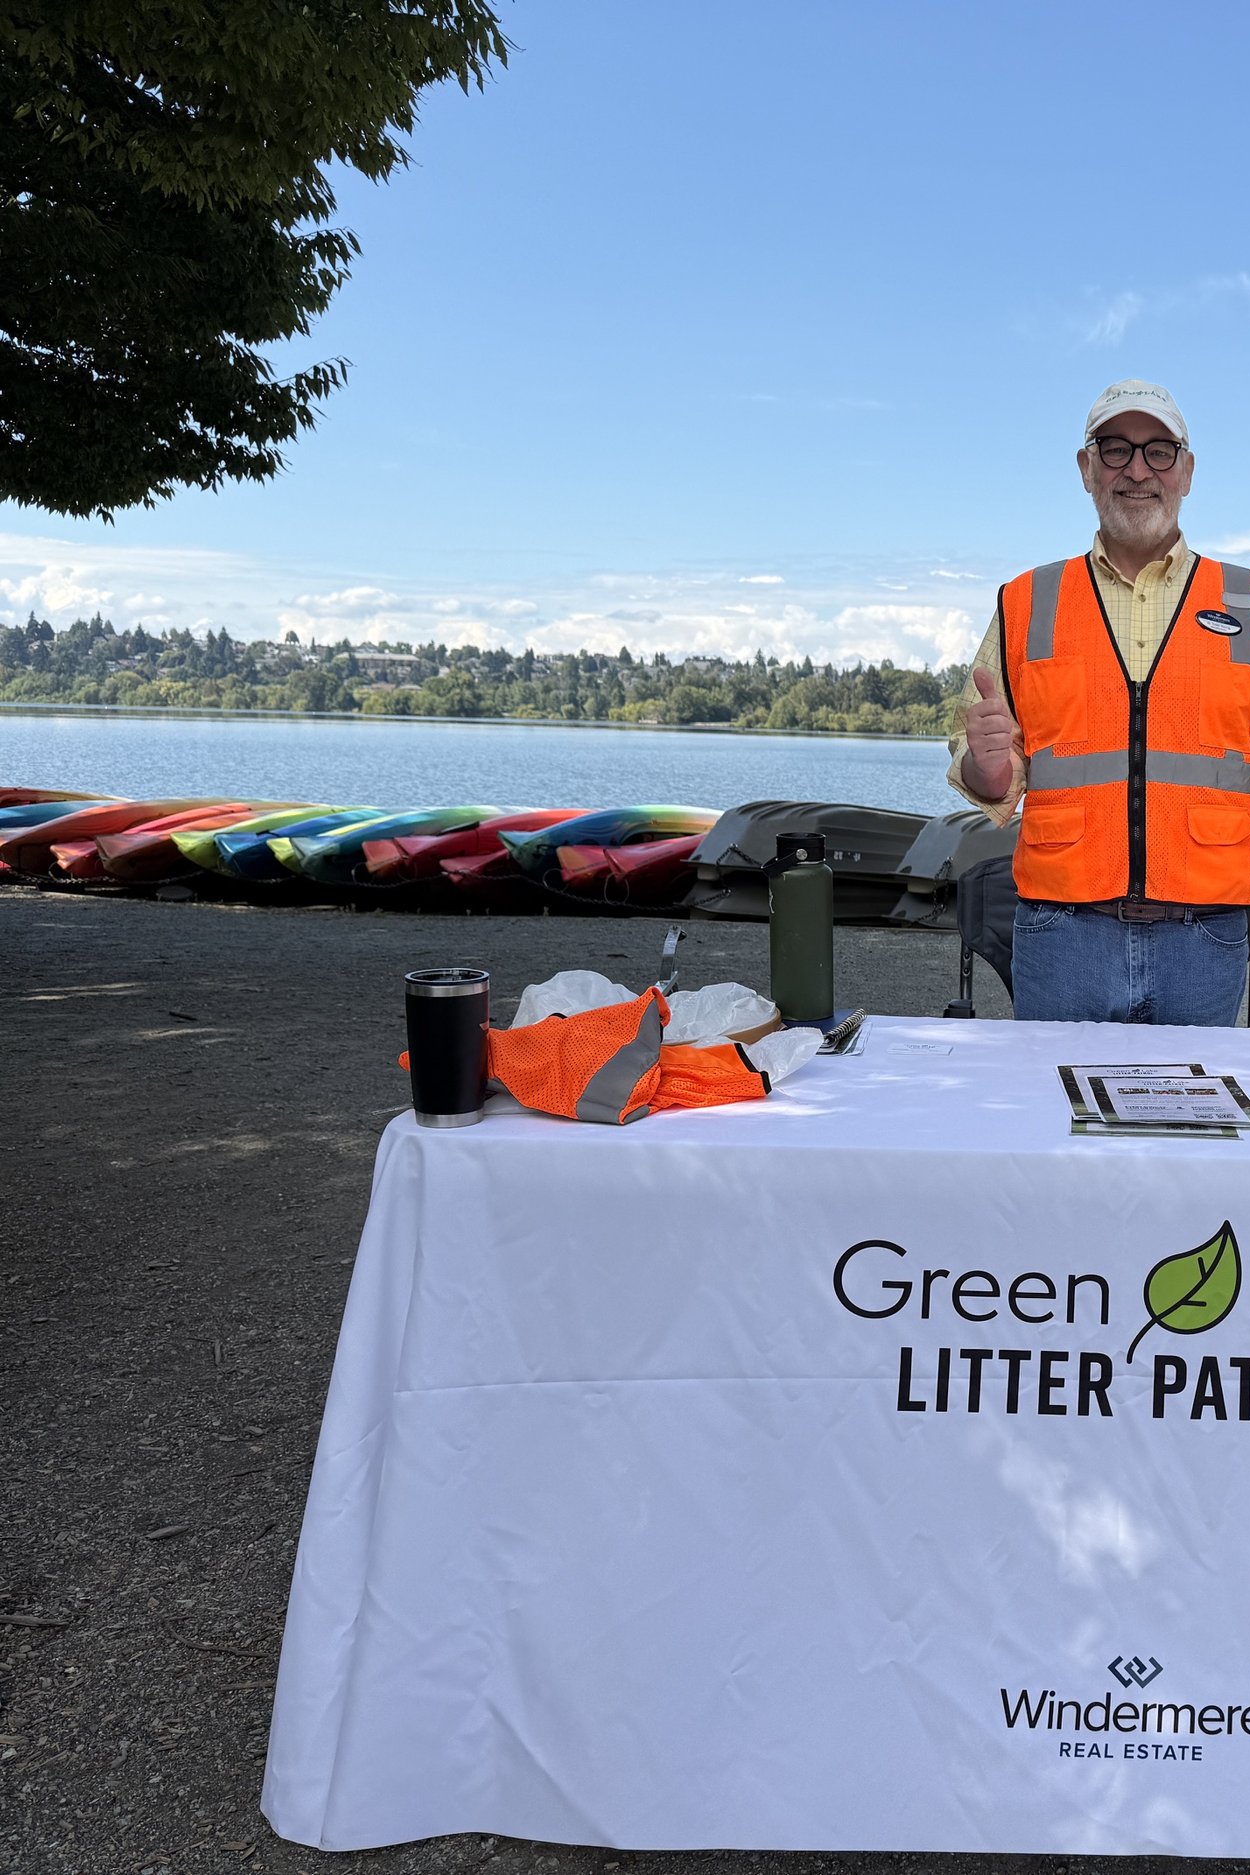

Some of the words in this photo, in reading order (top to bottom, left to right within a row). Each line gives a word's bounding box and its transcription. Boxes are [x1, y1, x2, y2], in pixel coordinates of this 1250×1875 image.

[832, 1239, 1110, 1325] Green
[896, 1346, 1114, 1417] LITTER
[1059, 1741, 1114, 1759] REAL
[1123, 1743, 1203, 1762] ESTATE
